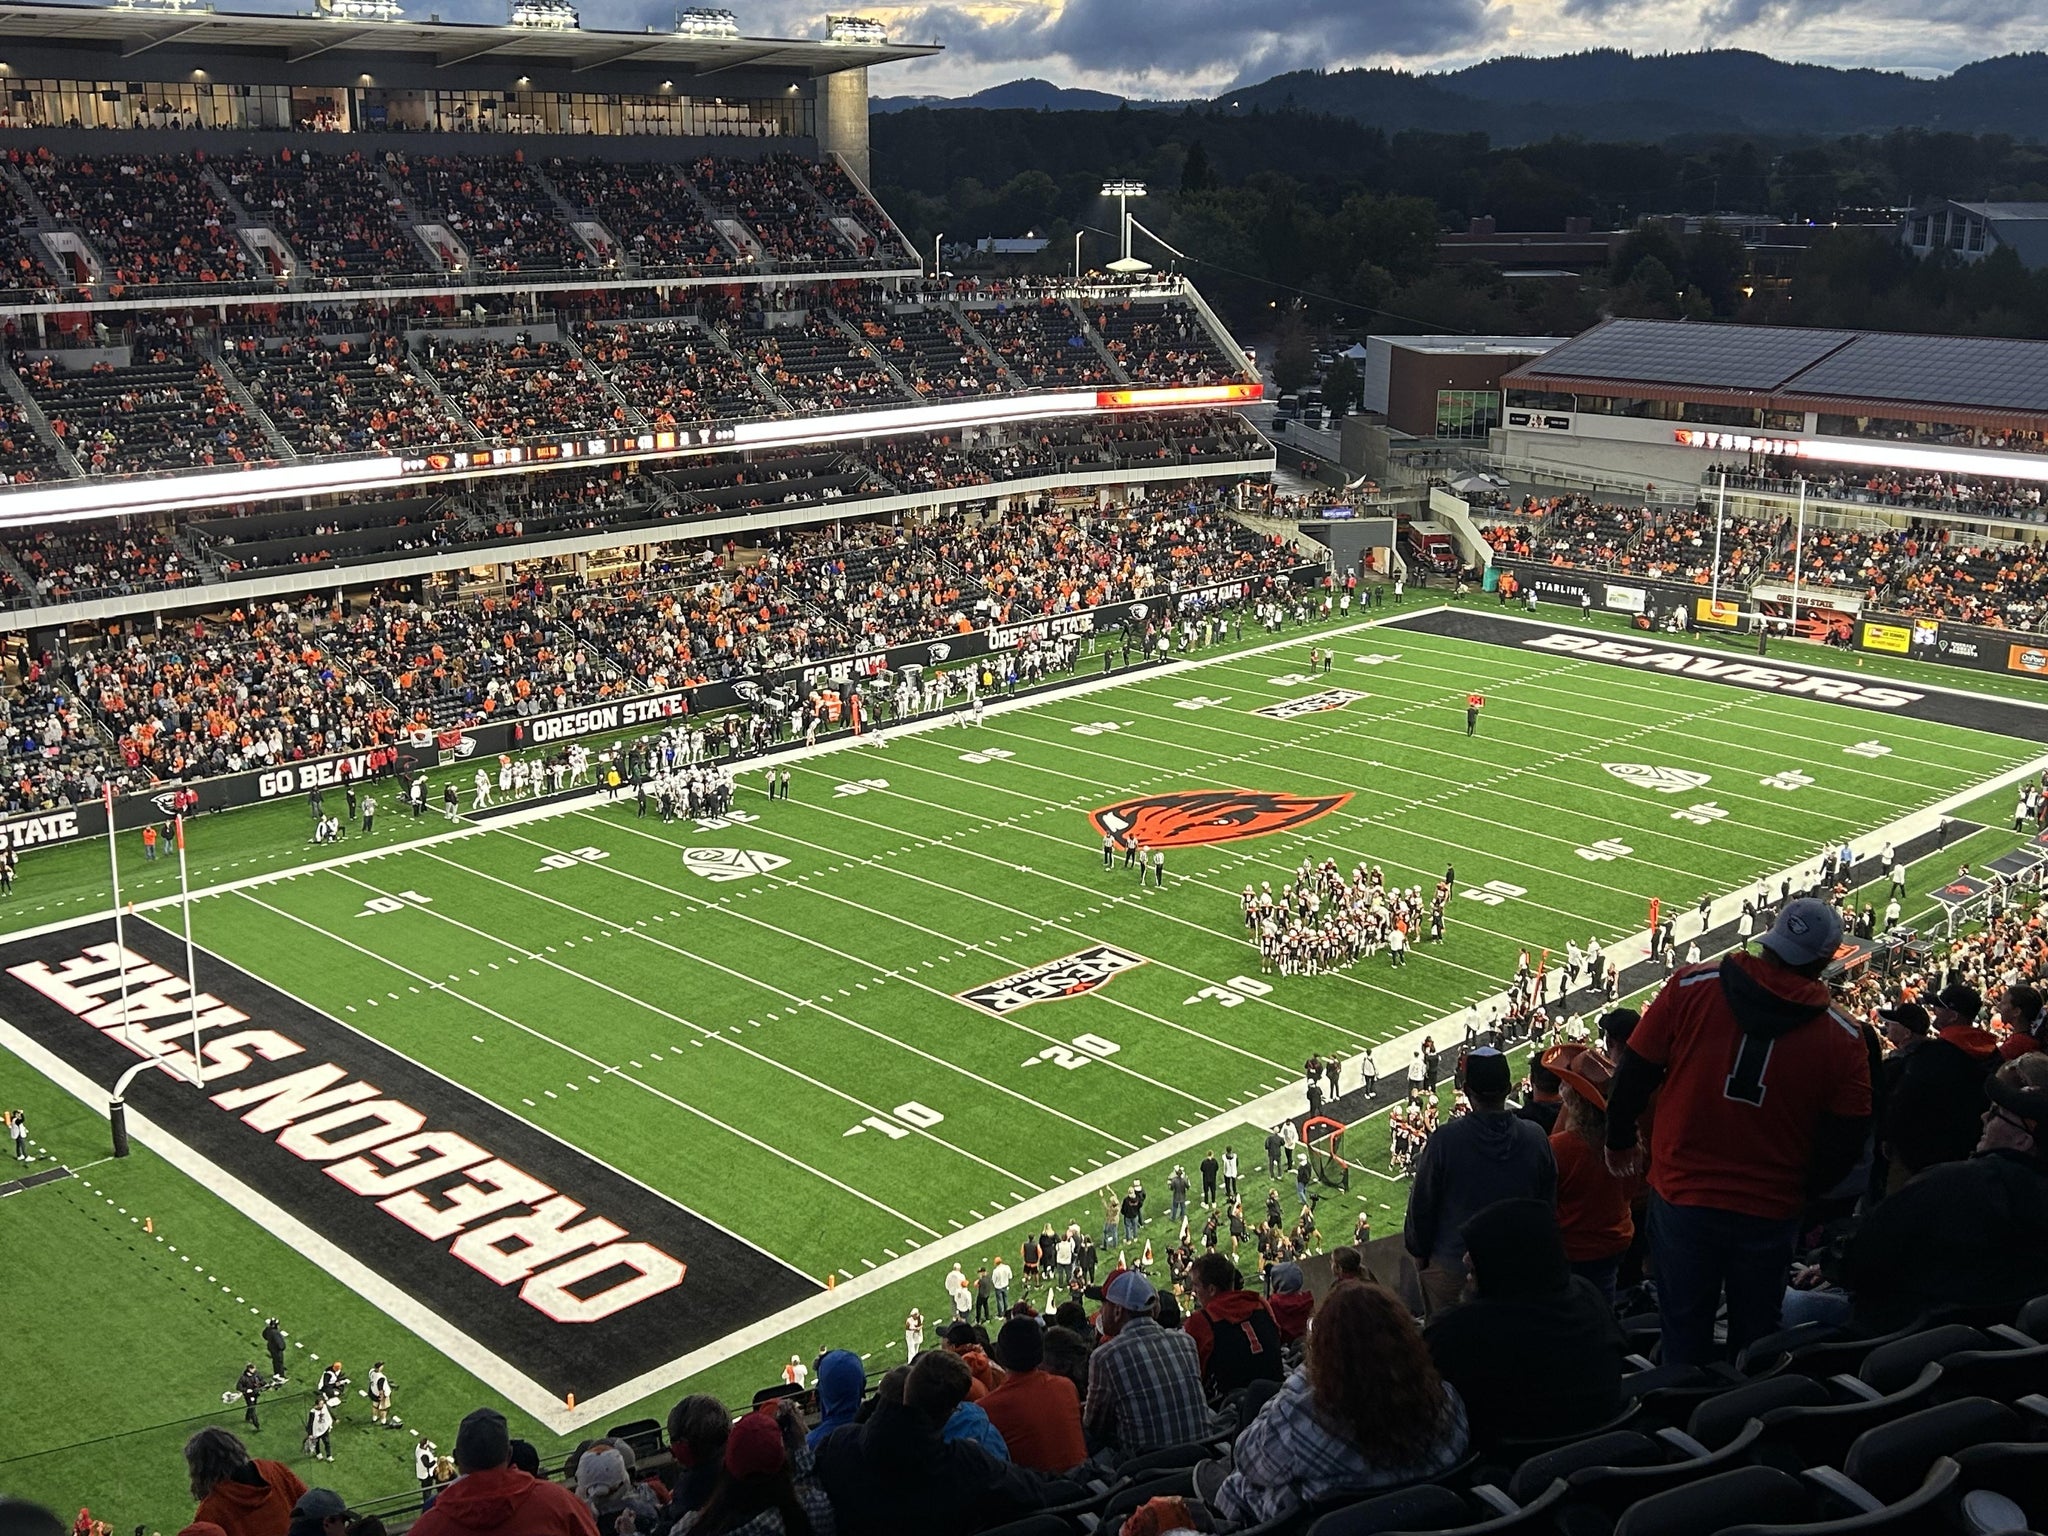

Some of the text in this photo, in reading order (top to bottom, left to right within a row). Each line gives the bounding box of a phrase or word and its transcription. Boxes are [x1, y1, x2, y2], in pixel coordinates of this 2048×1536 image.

[1535, 581, 1585, 596] STARLINK
[1810, 599, 1834, 608] STATE
[1522, 633, 1925, 707] BEAVERS
[532, 706, 618, 742] OREGON
[958, 748, 1016, 764] 50
[259, 769, 294, 797] GO
[834, 778, 890, 796] 40
[1759, 771, 1815, 790] 20
[1671, 804, 1729, 825] 30
[541, 846, 610, 869] 20
[1574, 840, 1634, 862] 40
[364, 890, 433, 914] 10
[1459, 880, 1528, 905] 50
[970, 950, 1127, 1010] RESER
[1198, 975, 1274, 1008] 30
[5, 942, 307, 1083] STATE
[1039, 1032, 1121, 1070] 20
[861, 1100, 945, 1140] 10
[209, 1062, 687, 1325] OREGON
[1240, 1320, 1264, 1354] 1
